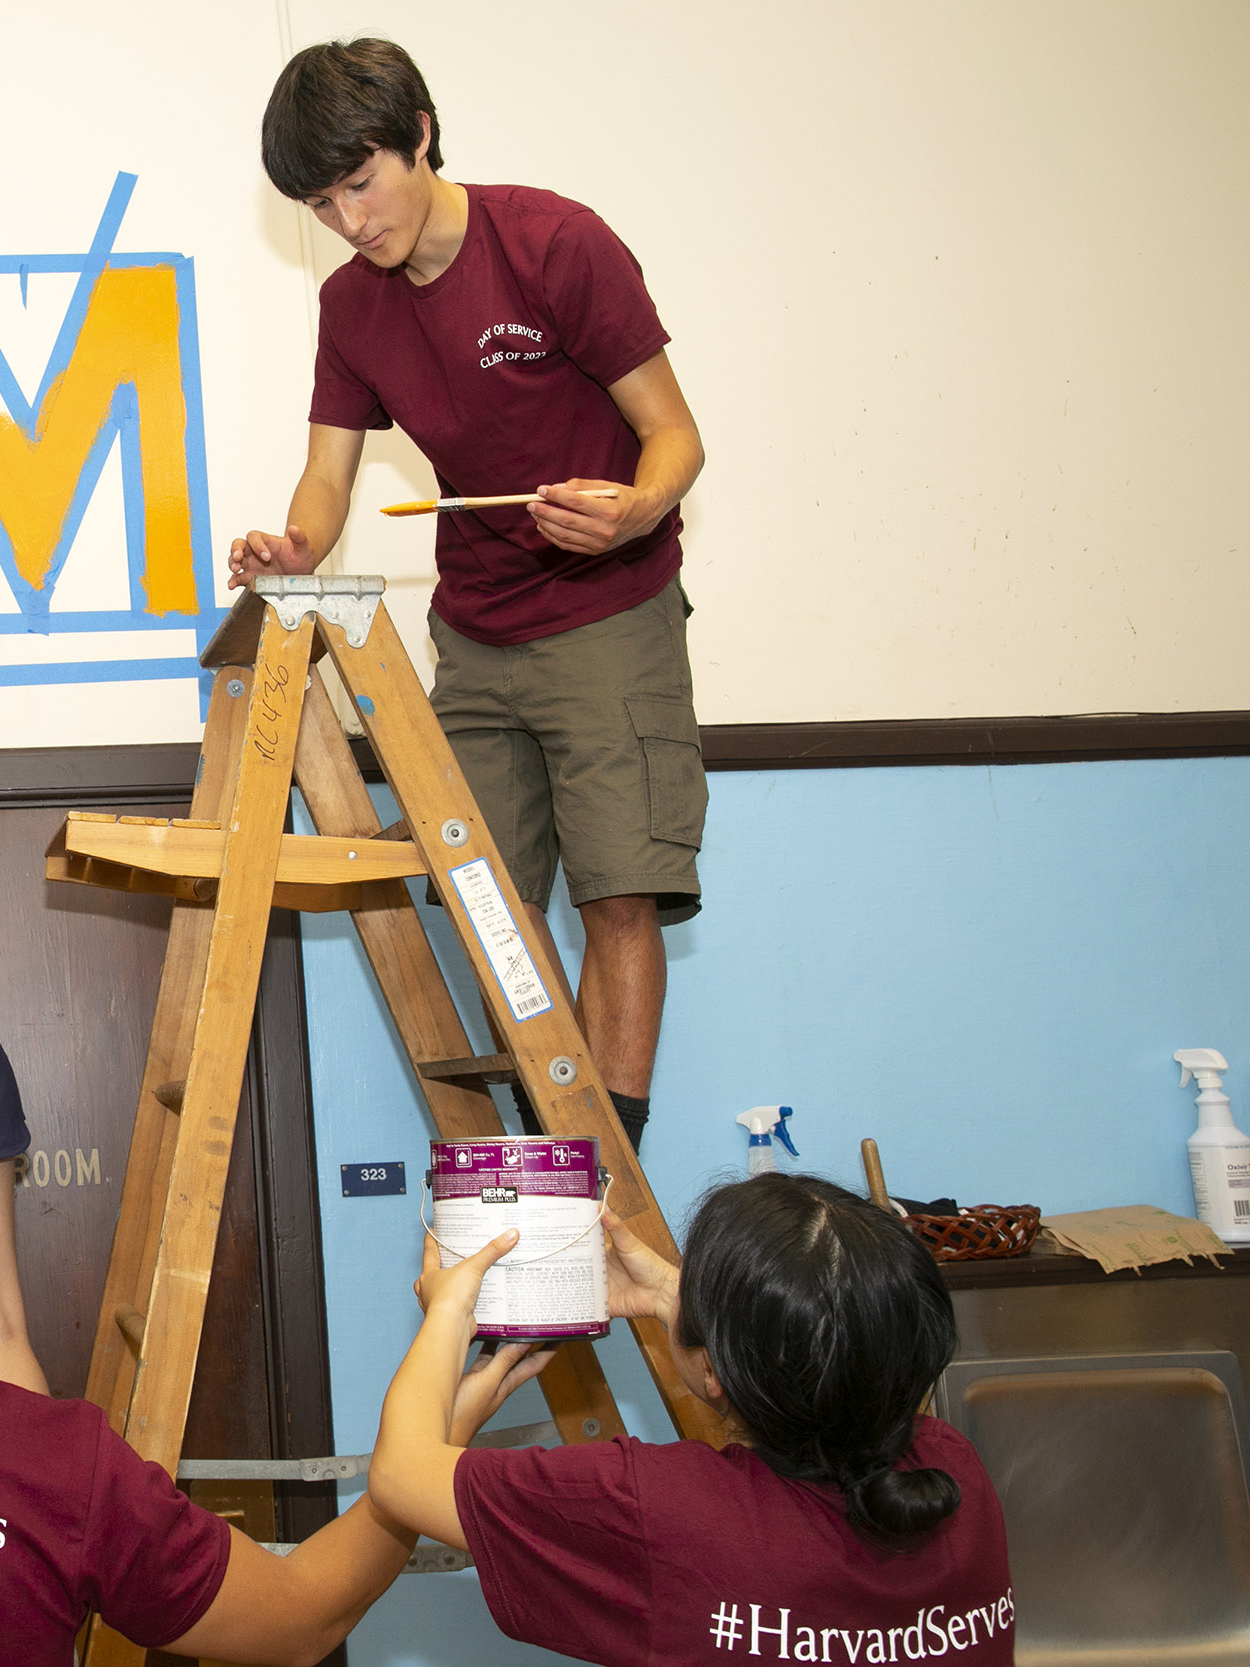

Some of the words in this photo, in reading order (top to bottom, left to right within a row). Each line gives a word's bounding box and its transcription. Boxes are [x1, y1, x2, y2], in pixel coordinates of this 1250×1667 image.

[477, 327, 492, 349] DAY
[493, 323, 505, 336] OF
[507, 323, 543, 342] SERVICE
[480, 351, 504, 369] CLASS
[505, 351, 521, 361] OF
[360, 1168, 387, 1181] 323
[482, 1188, 506, 1197] BEHR
[709, 1587, 1014, 1664] #HarvardServes
